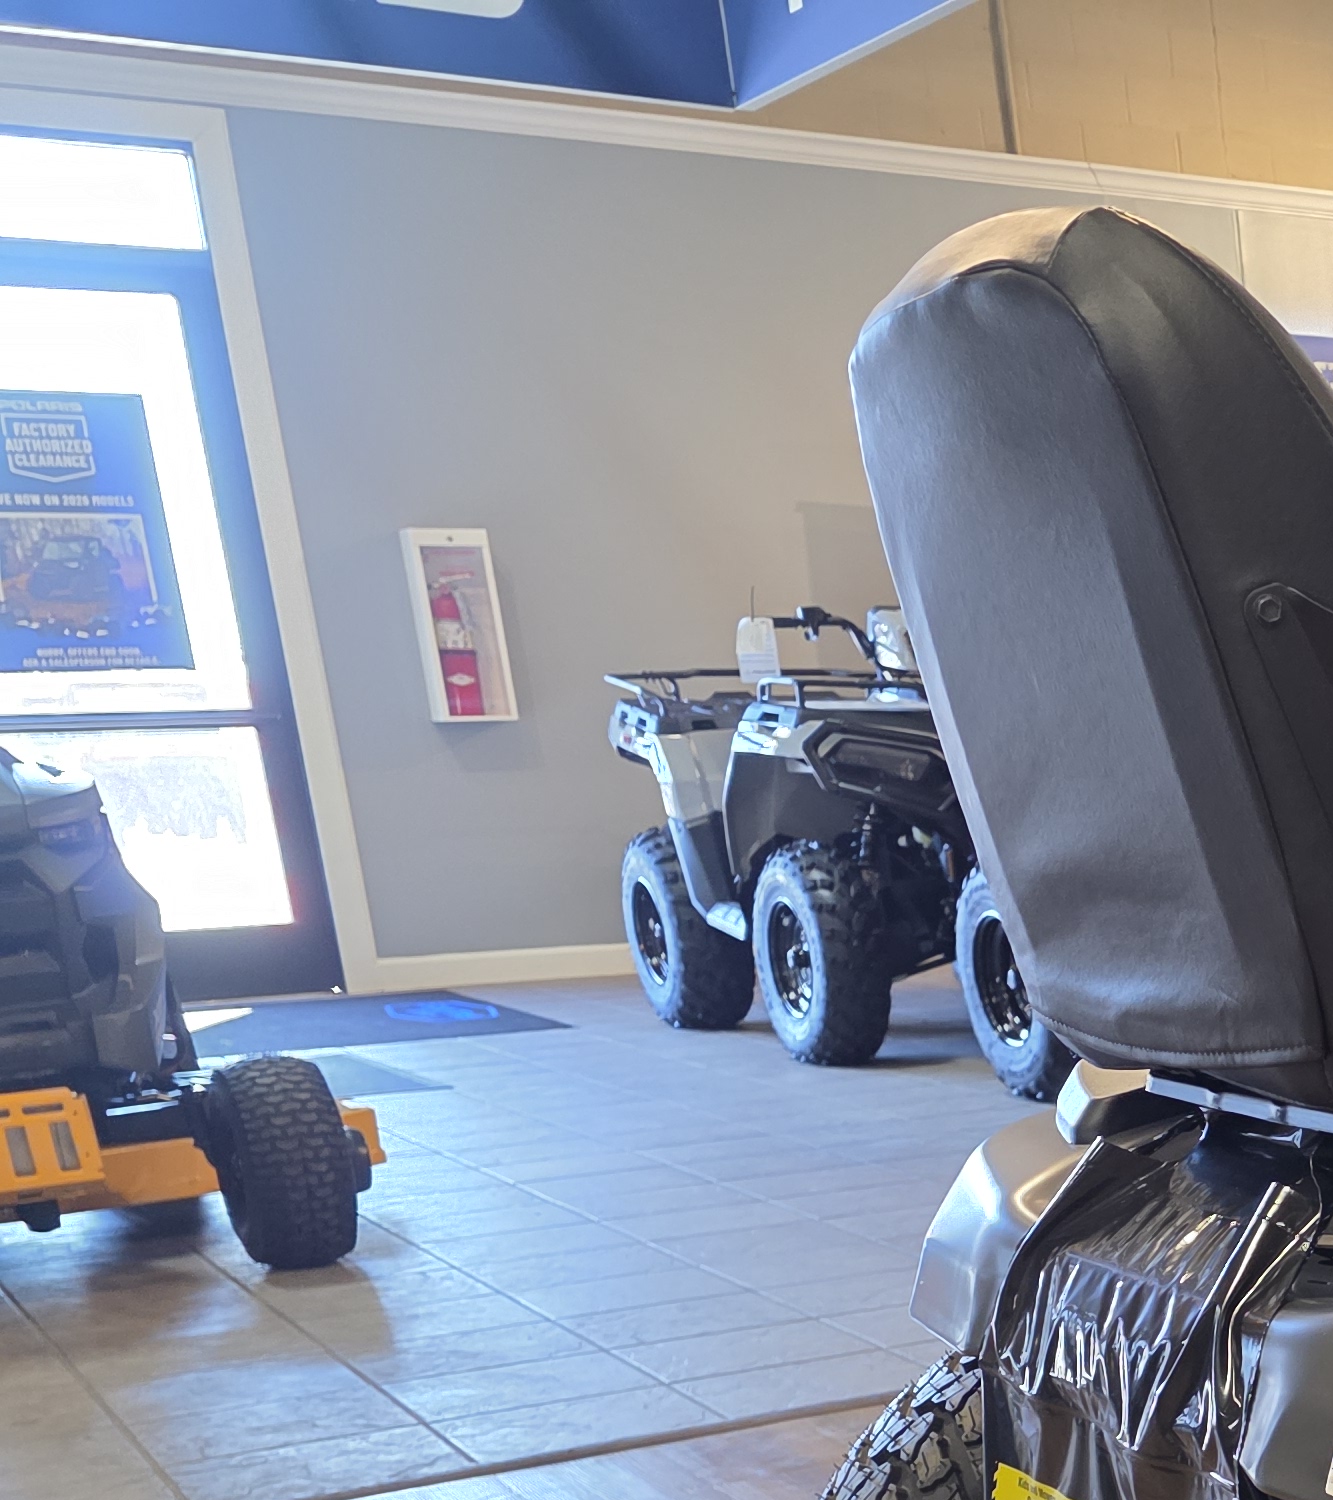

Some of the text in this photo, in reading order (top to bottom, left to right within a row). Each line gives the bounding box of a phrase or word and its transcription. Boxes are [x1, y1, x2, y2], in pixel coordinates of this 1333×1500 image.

[13, 422, 75, 437] FACTORY
[6, 438, 93, 454] AUTHORIZED
[15, 454, 88, 468] CLEARANCE
